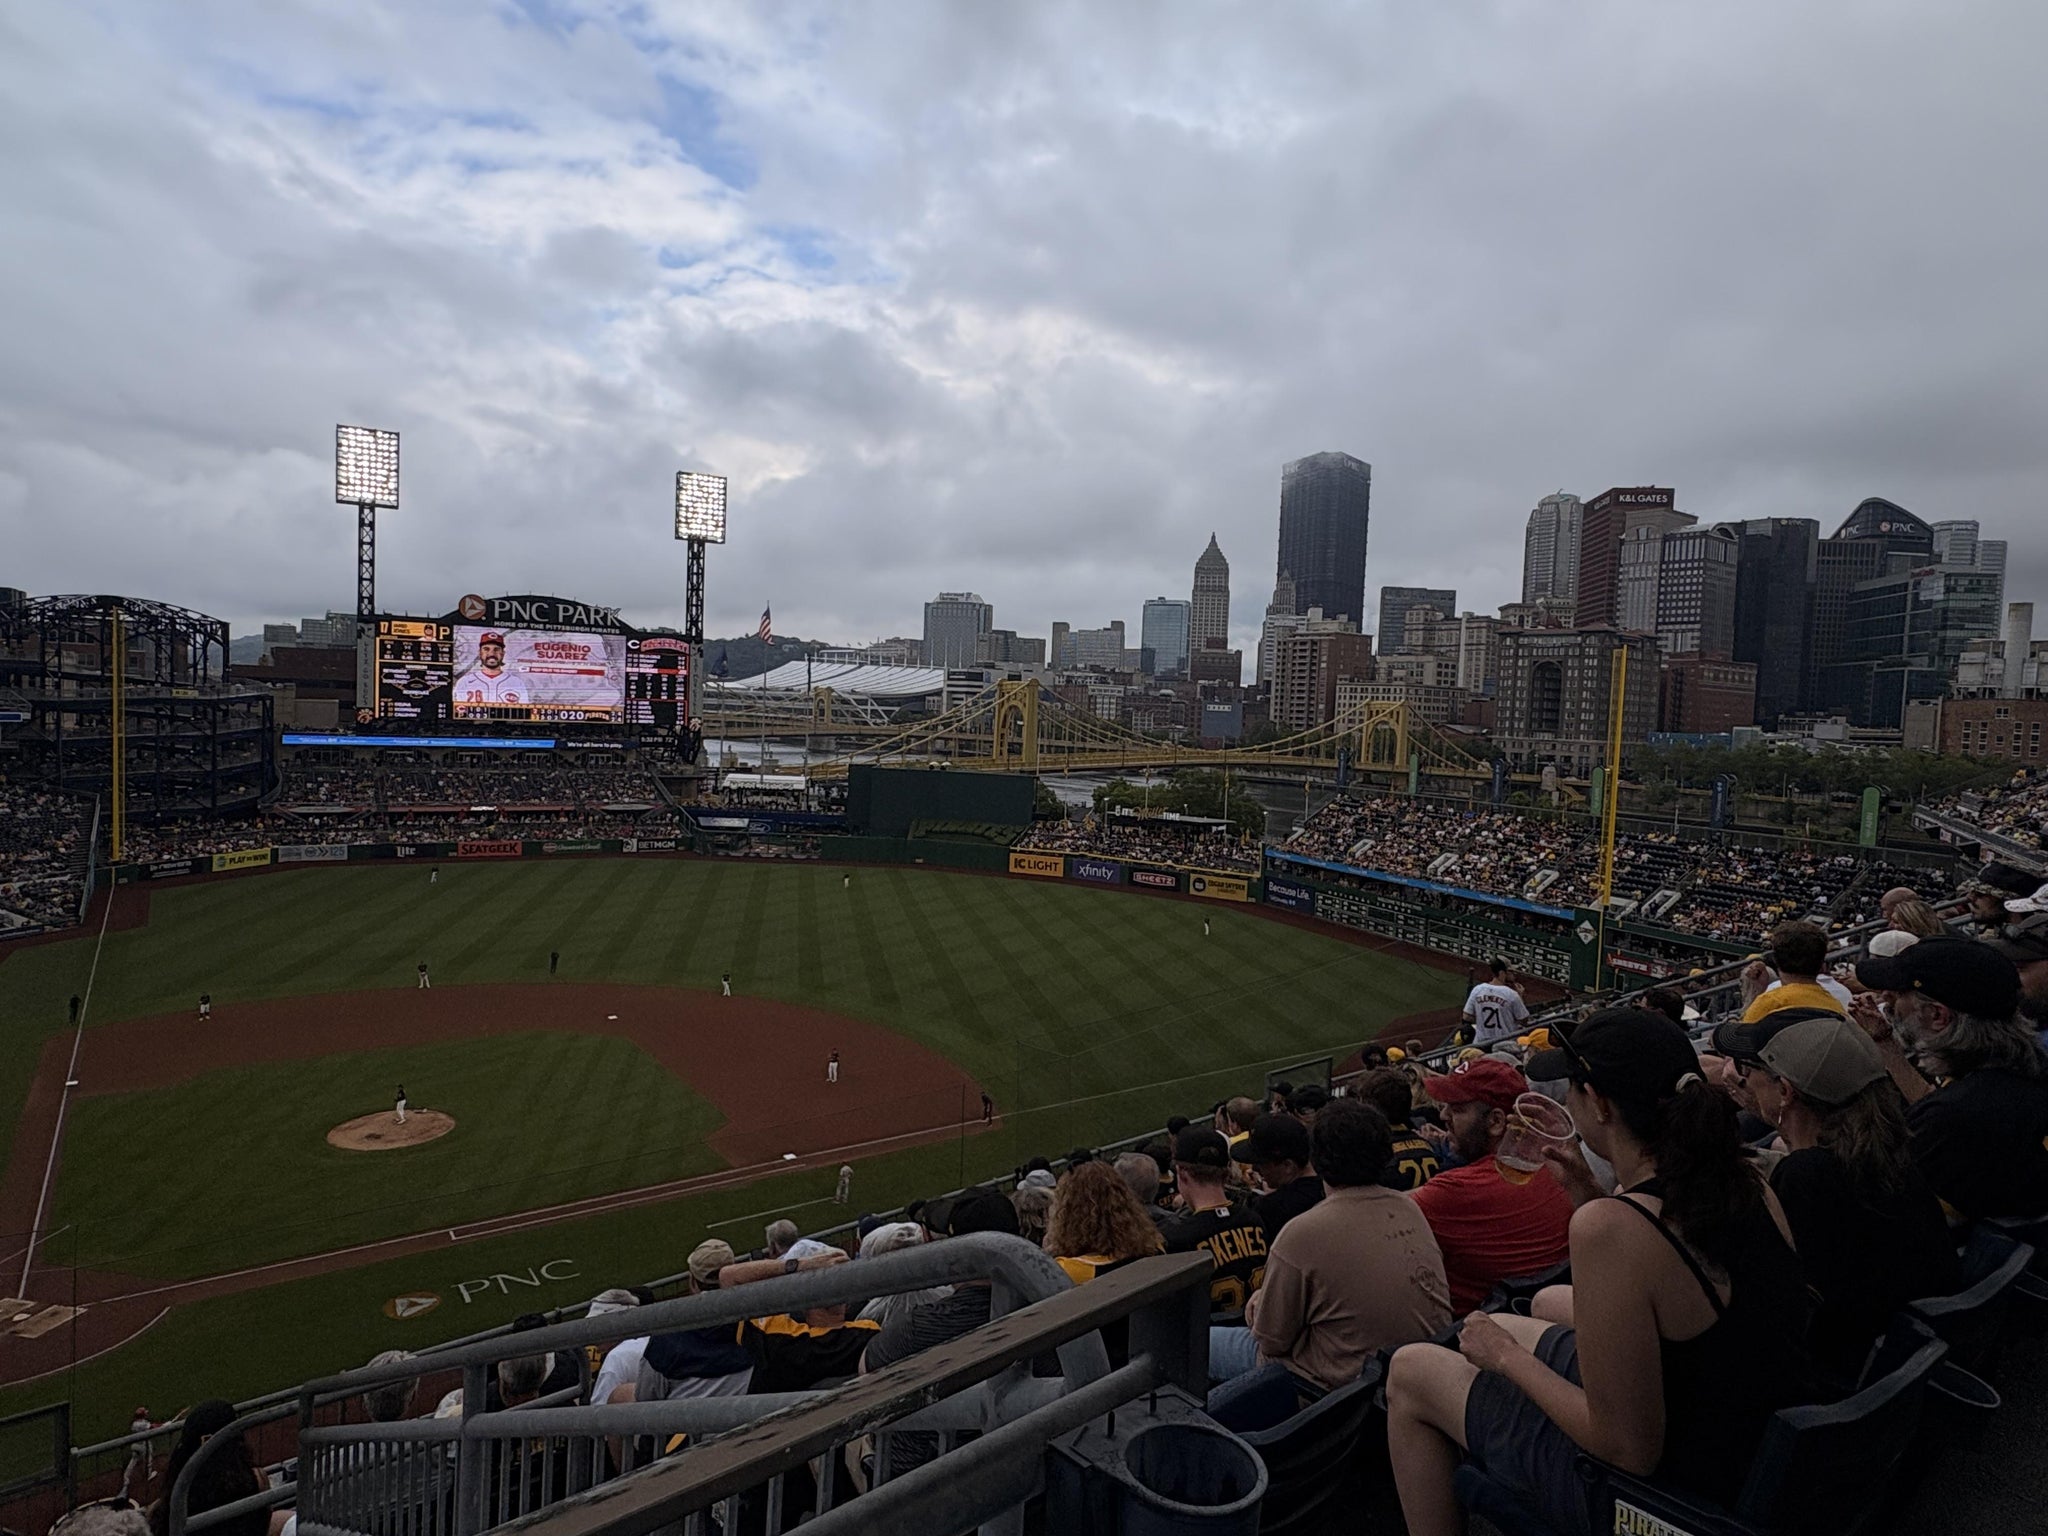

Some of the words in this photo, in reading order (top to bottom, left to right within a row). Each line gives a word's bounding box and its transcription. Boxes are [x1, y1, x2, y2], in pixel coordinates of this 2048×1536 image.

[1619, 494, 1636, 503] K&L
[1637, 494, 1668, 503] GATES
[1892, 522, 1914, 534] PNC
[491, 599, 550, 622] PNC
[556, 604, 622, 627] PARK
[545, 624, 590, 632] PITTSBURGH
[591, 626, 620, 634] PIRATES
[534, 642, 591, 653] EUGENIO
[537, 650, 588, 661] SUAREZ
[1163, 811, 1180, 821] TIME
[461, 842, 518, 854] SEATGEEK
[639, 840, 676, 849] BETMGM
[397, 846, 416, 858] Lite
[229, 856, 246, 865] PLAY
[1014, 858, 1026, 869] IC
[1027, 860, 1059, 872] LIGHT
[1079, 864, 1114, 880] xfinity
[1135, 873, 1173, 885] SHEETZ
[1268, 881, 1297, 897] Because
[1482, 1007, 1502, 1029] 21
[450, 1259, 581, 1304] PNC
[1210, 1265, 1265, 1312] 3
[1615, 1502, 1690, 1536] PIRA
